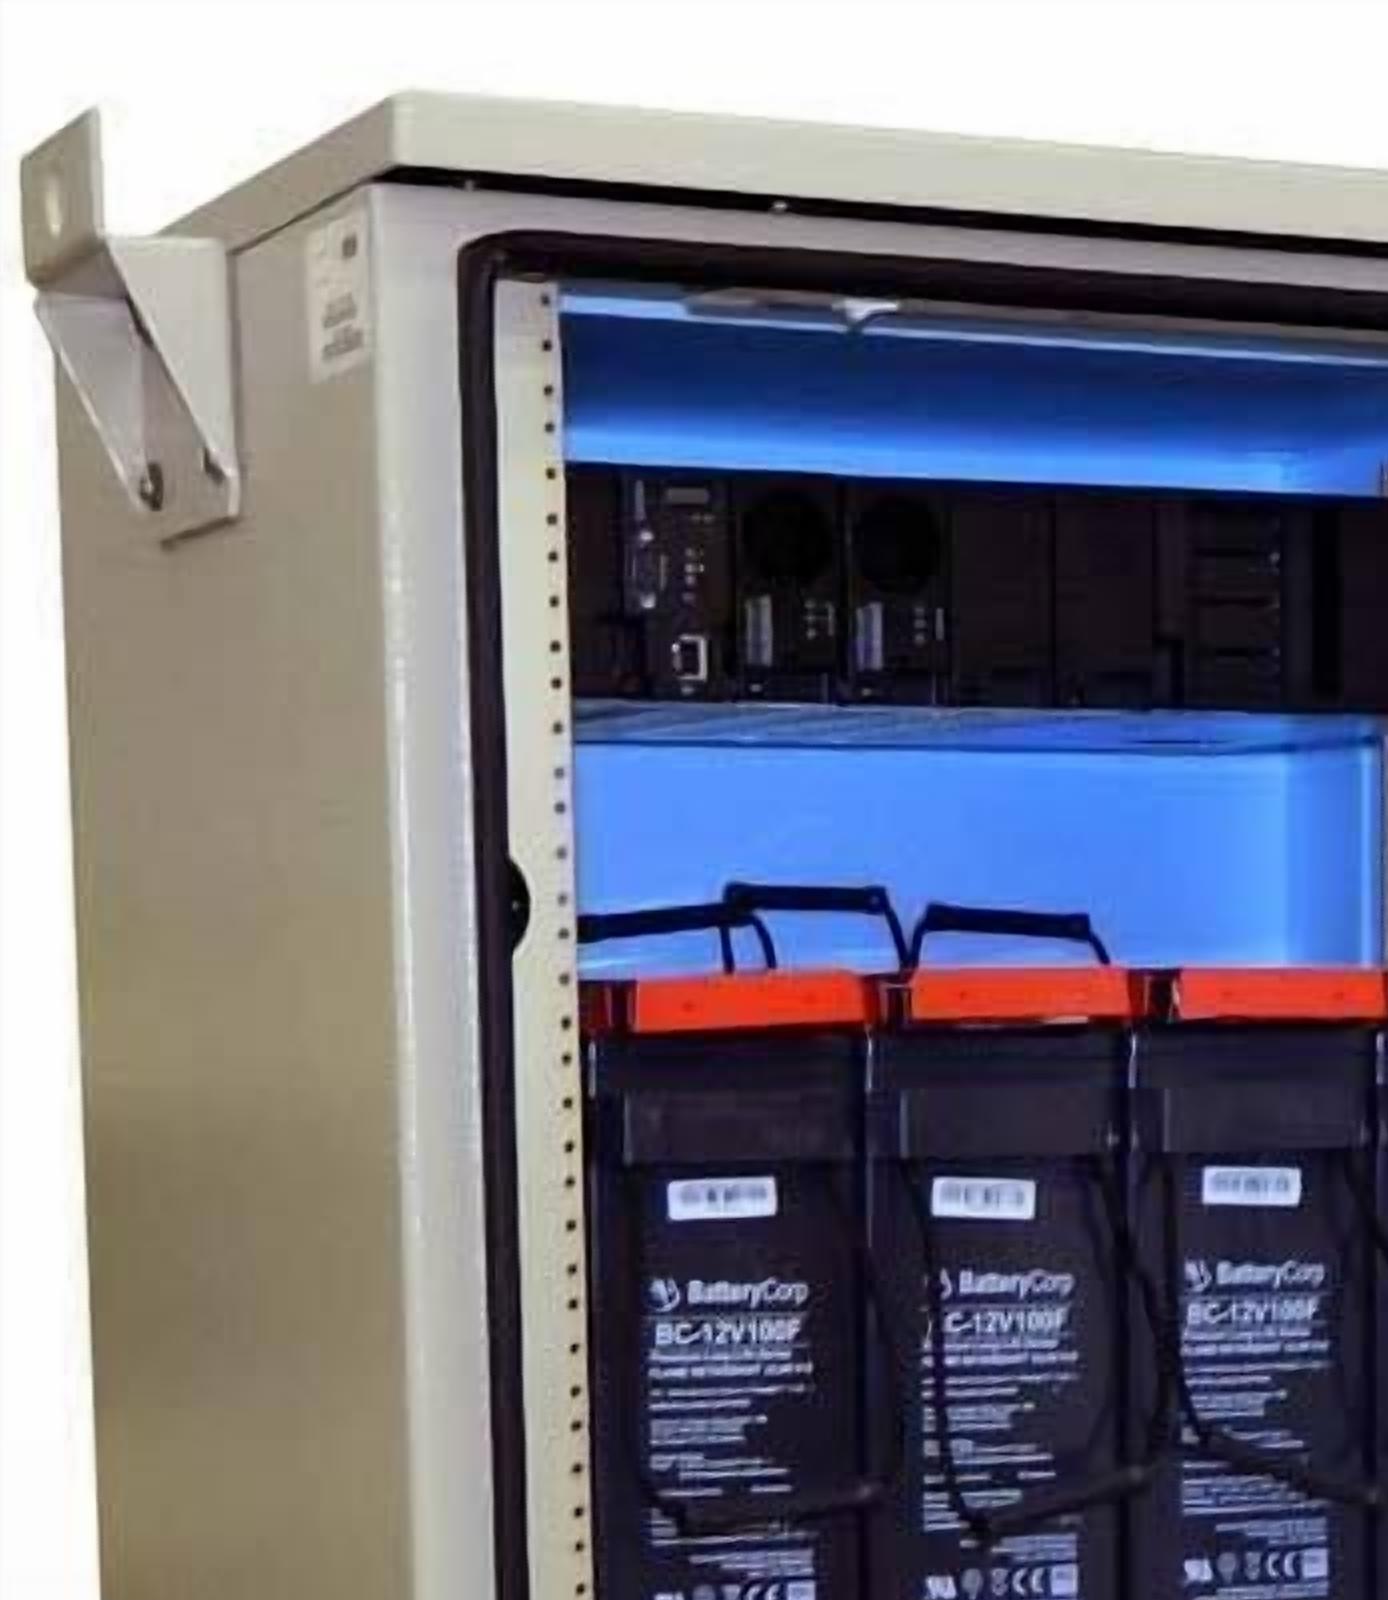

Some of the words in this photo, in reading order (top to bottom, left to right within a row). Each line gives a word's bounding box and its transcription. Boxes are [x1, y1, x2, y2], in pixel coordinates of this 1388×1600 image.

[959, 1268, 1074, 1299] BatteryCorp
[1216, 1259, 1325, 1288] BatteryCorp
[687, 1276, 808, 1309] BatteryCorp
[655, 1317, 801, 1345] BC-12V100F
[943, 1306, 1068, 1333] C-12V100F
